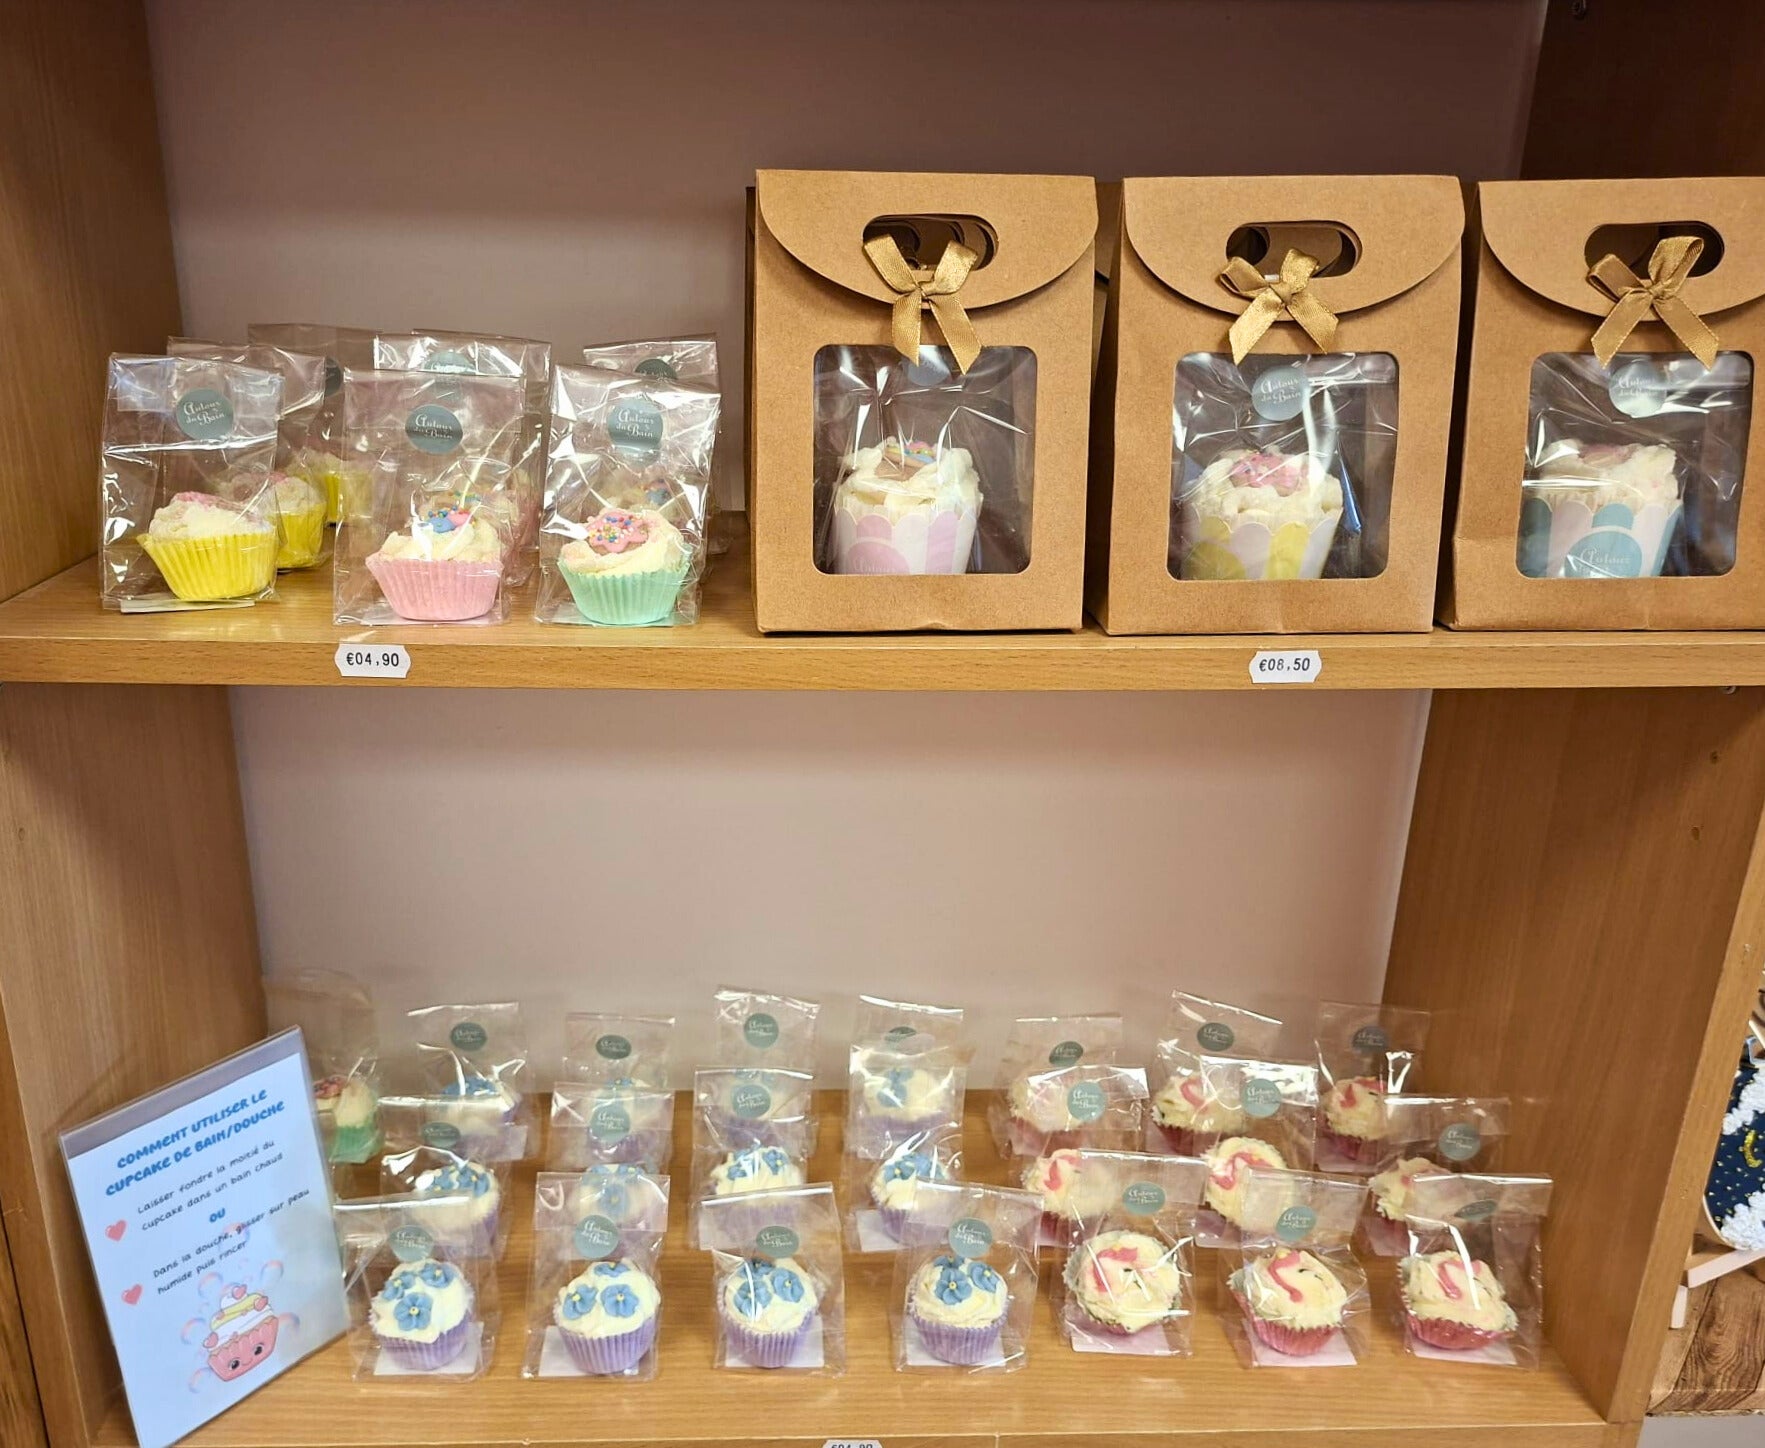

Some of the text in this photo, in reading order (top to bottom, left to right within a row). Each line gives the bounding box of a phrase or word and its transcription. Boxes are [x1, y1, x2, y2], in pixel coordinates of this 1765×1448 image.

[183, 401, 220, 416] Autour
[618, 408, 654, 424] Autour
[346, 652, 400, 667] €04,90
[1259, 657, 1311, 672] €08,50
[105, 1101, 286, 1196] CUPCAKE DE BAIN/DOUCHE
[117, 1089, 268, 1169] COMMENT UTILISER LE
[137, 1139, 275, 1214] Laisser fondre la moitié du
[142, 1153, 284, 1231] cupcake dans un bain chaud
[153, 1260, 179, 1278] Dans
[181, 1252, 192, 1264] la
[269, 1201, 284, 1215] sur
[287, 1188, 310, 1206] peau
[209, 1207, 226, 1223] OU
[157, 1240, 247, 1294] humide puis rincer
